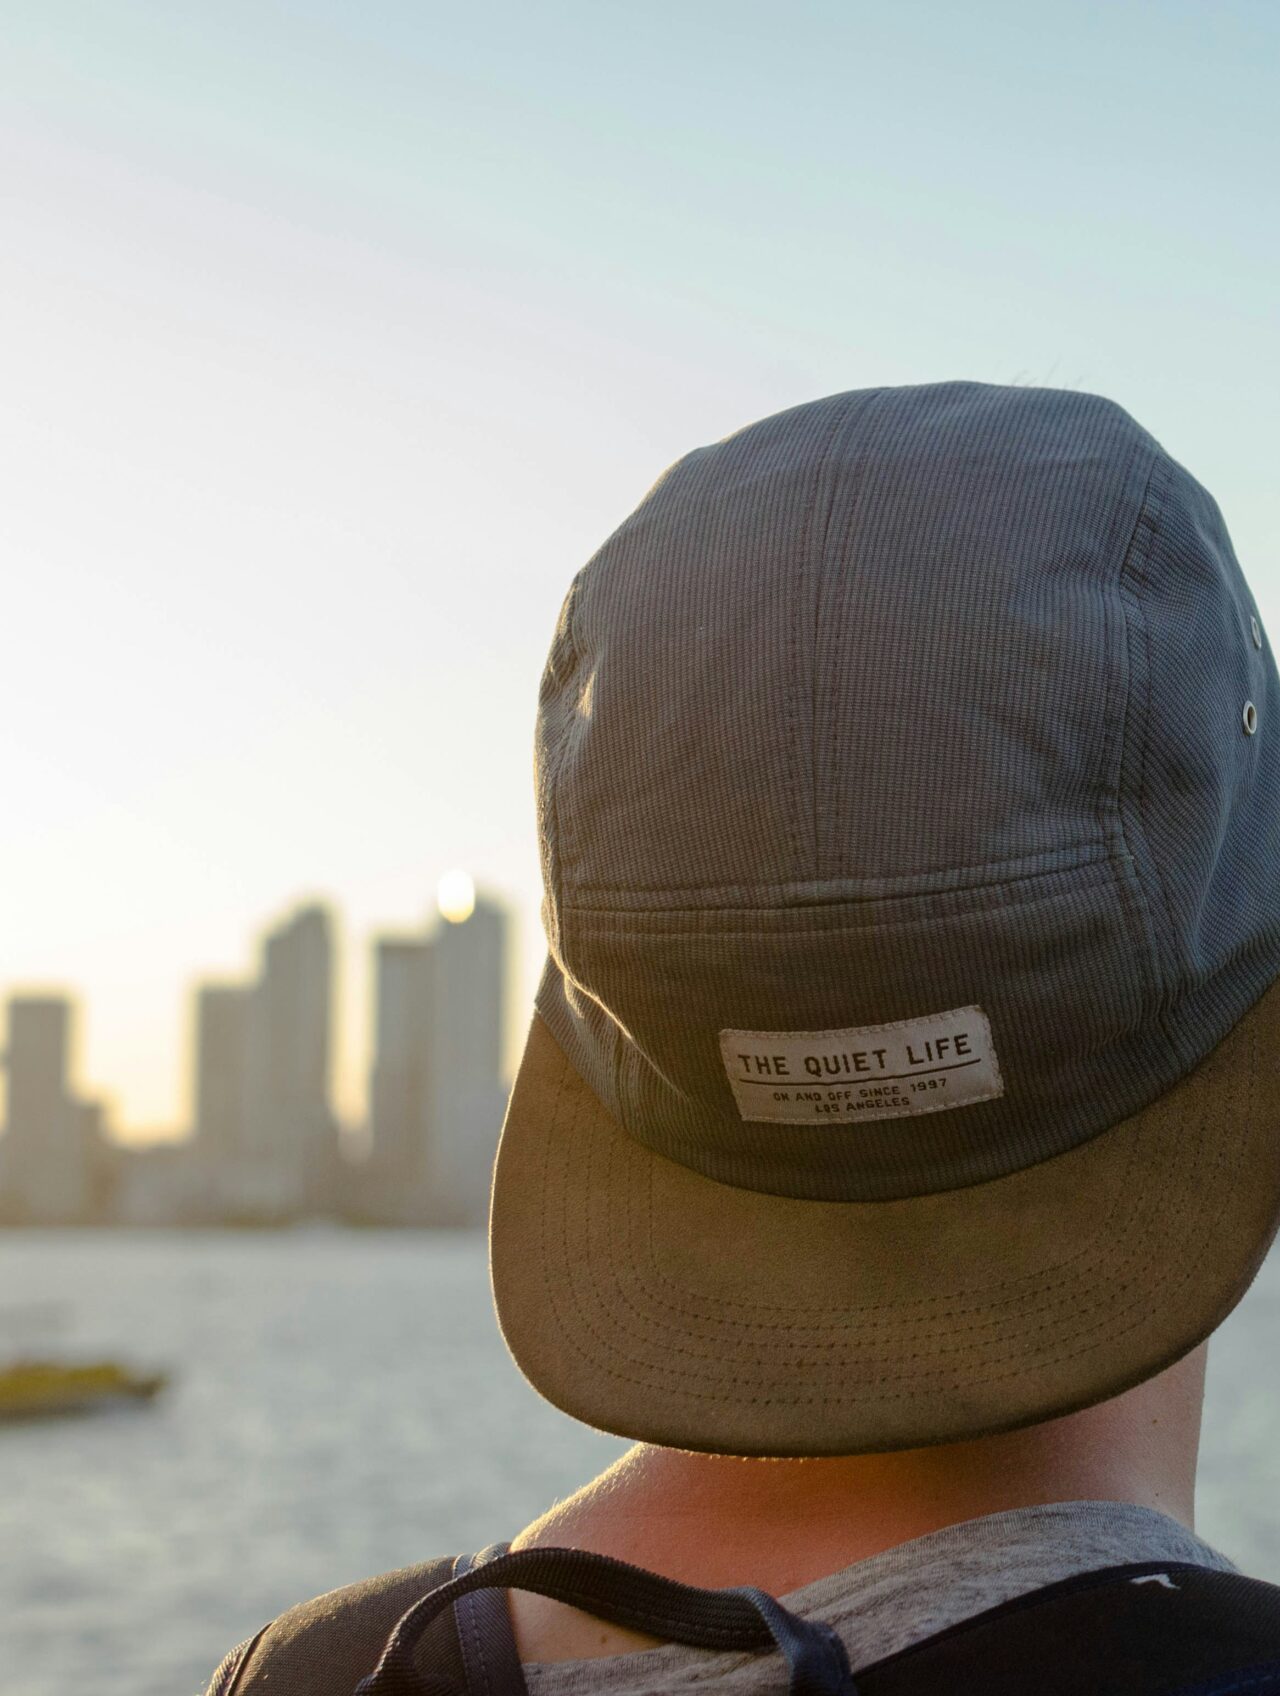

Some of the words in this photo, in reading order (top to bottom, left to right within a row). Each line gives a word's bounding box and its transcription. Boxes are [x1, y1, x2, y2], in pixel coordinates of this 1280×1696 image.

[738, 1054, 790, 1076] THE
[804, 1049, 887, 1078] QUIET
[906, 1034, 972, 1066] LIFE
[773, 1092, 790, 1102] ON
[796, 1092, 822, 1102] AND
[828, 1090, 852, 1101] OFF
[859, 1086, 901, 1098] SINCE
[910, 1078, 948, 1092] 1997
[815, 1103, 840, 1113] LOS
[846, 1096, 910, 1112] ANGELES
